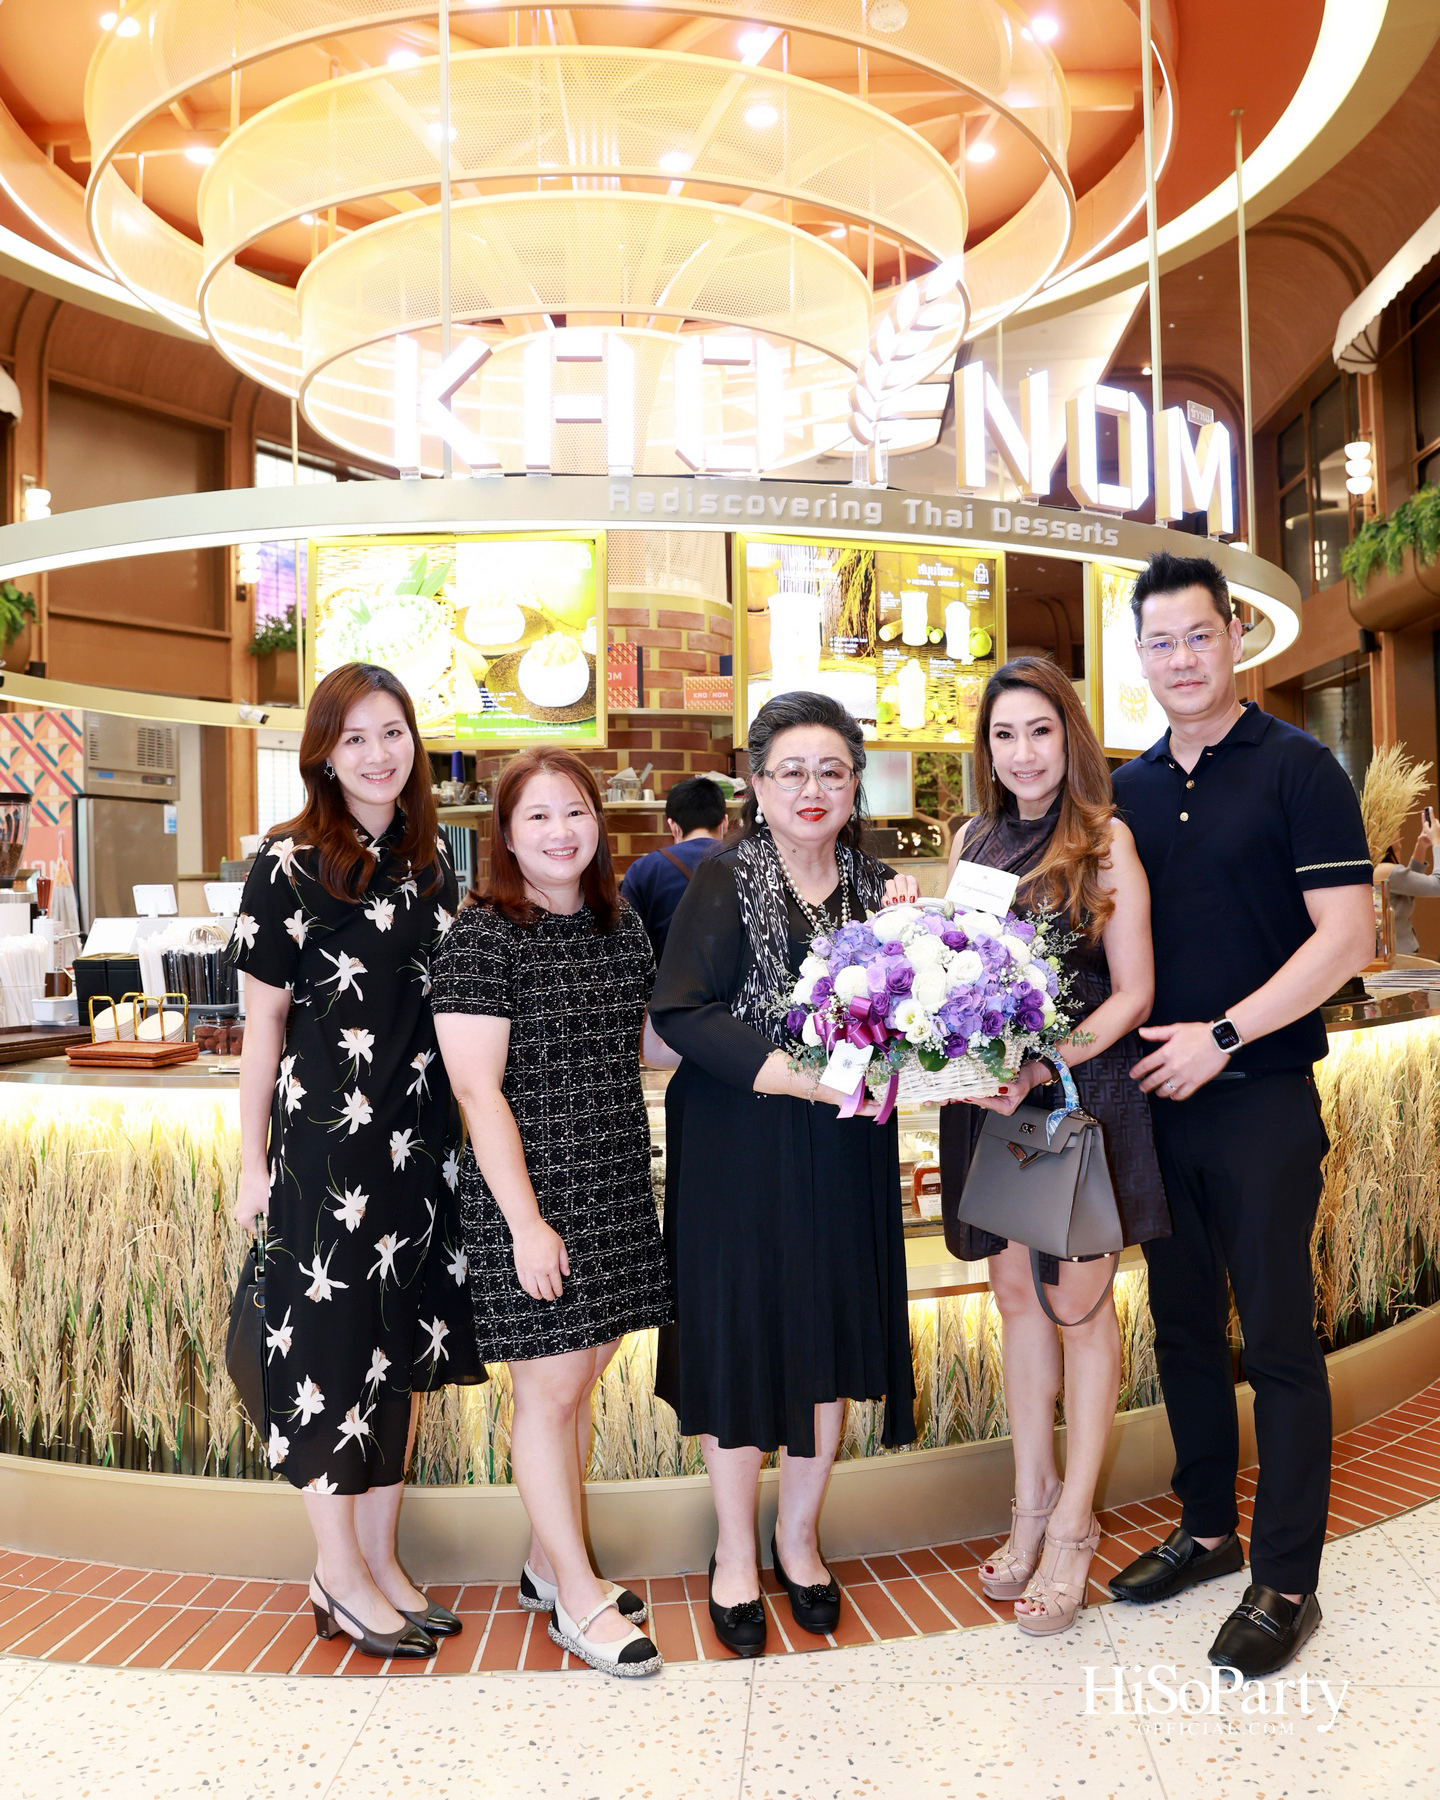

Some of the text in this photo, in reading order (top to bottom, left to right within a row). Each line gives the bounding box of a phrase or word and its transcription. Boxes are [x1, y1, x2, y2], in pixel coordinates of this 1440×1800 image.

[952, 359, 1236, 537] NOM
[607, 483, 1119, 548] Rediscovering Thai Desserts
